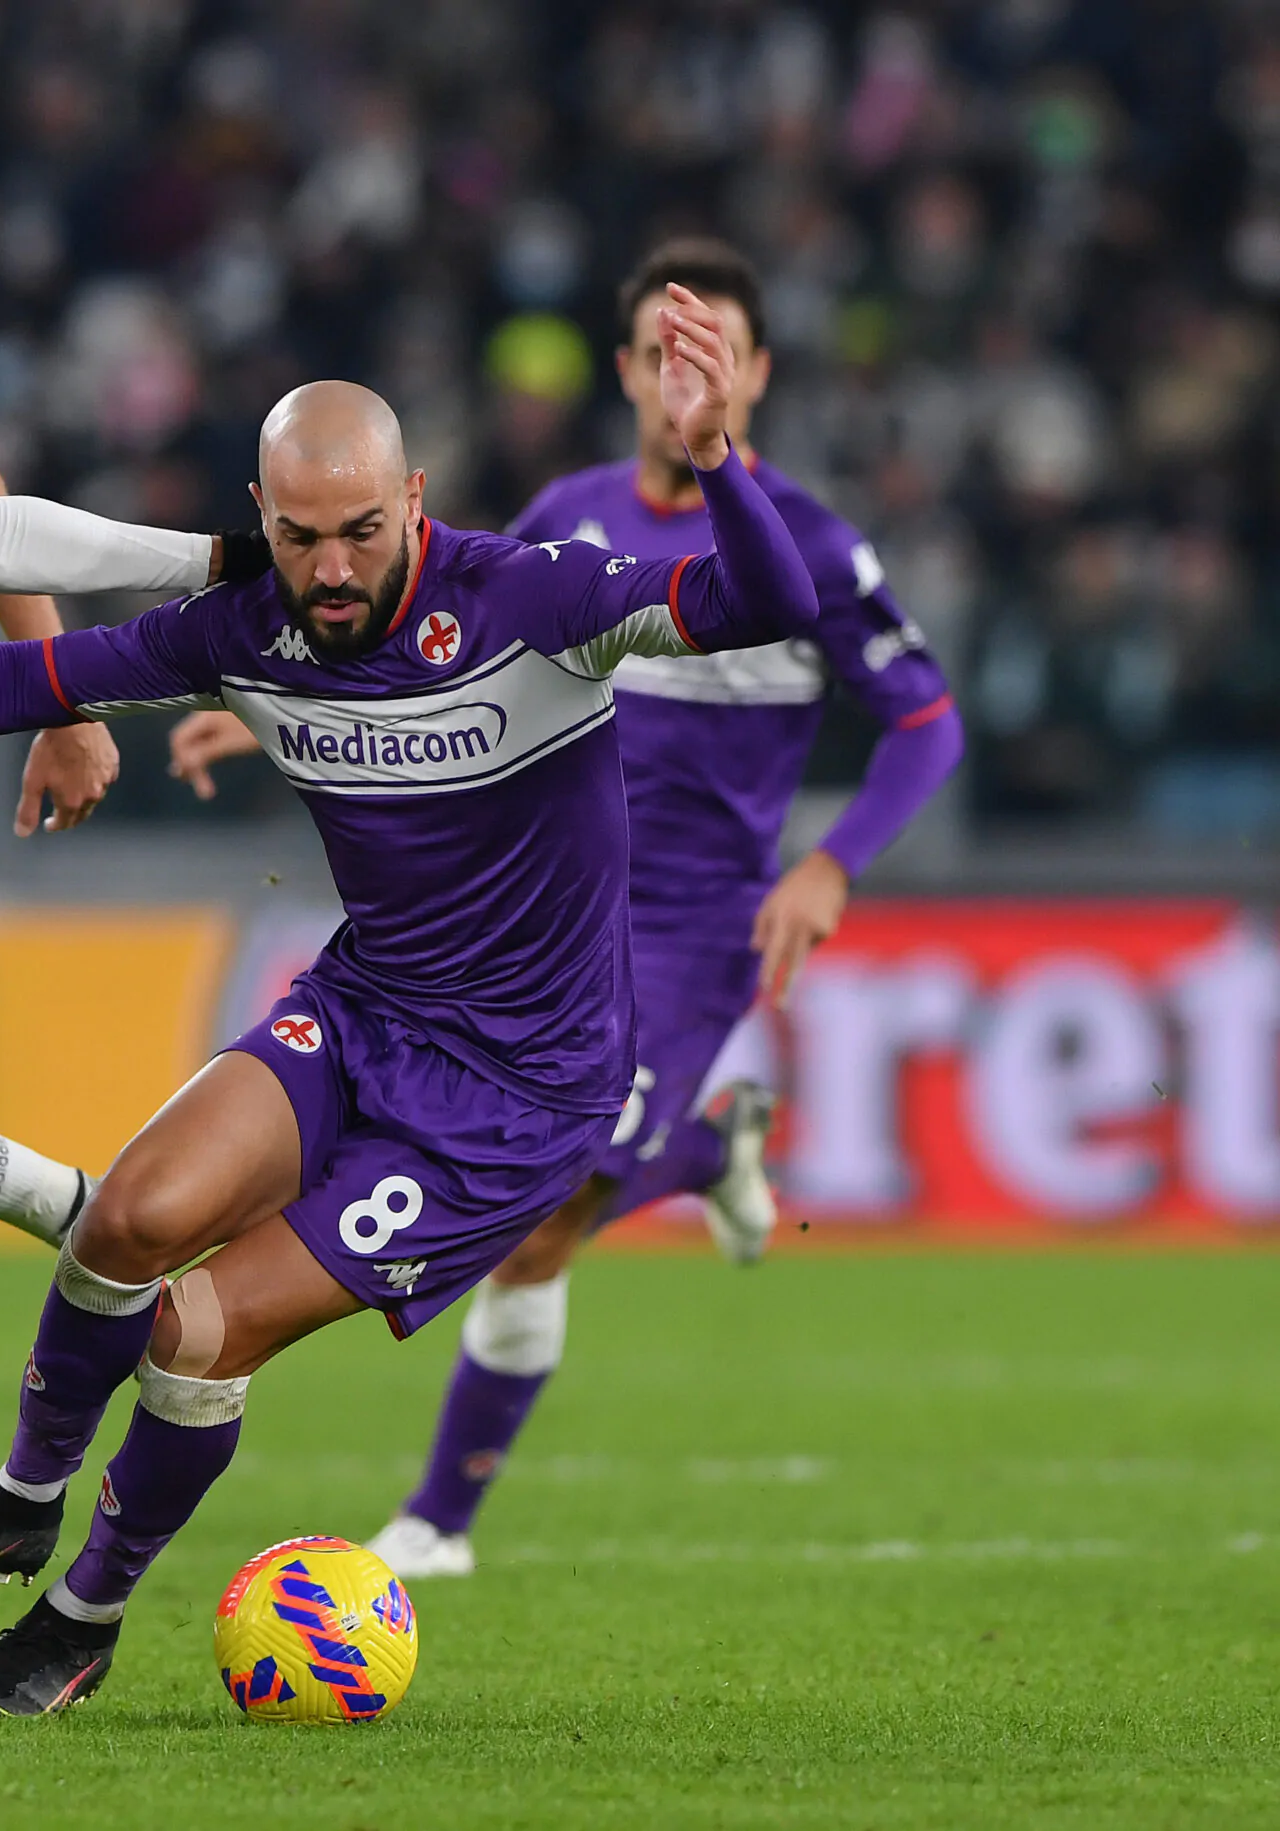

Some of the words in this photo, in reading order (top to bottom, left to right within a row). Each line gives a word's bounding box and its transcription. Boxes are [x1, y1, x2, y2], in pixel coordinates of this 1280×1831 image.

[276, 721, 491, 767] Mediacom
[685, 908, 1280, 1212] ret
[339, 1175, 424, 1254] 8
